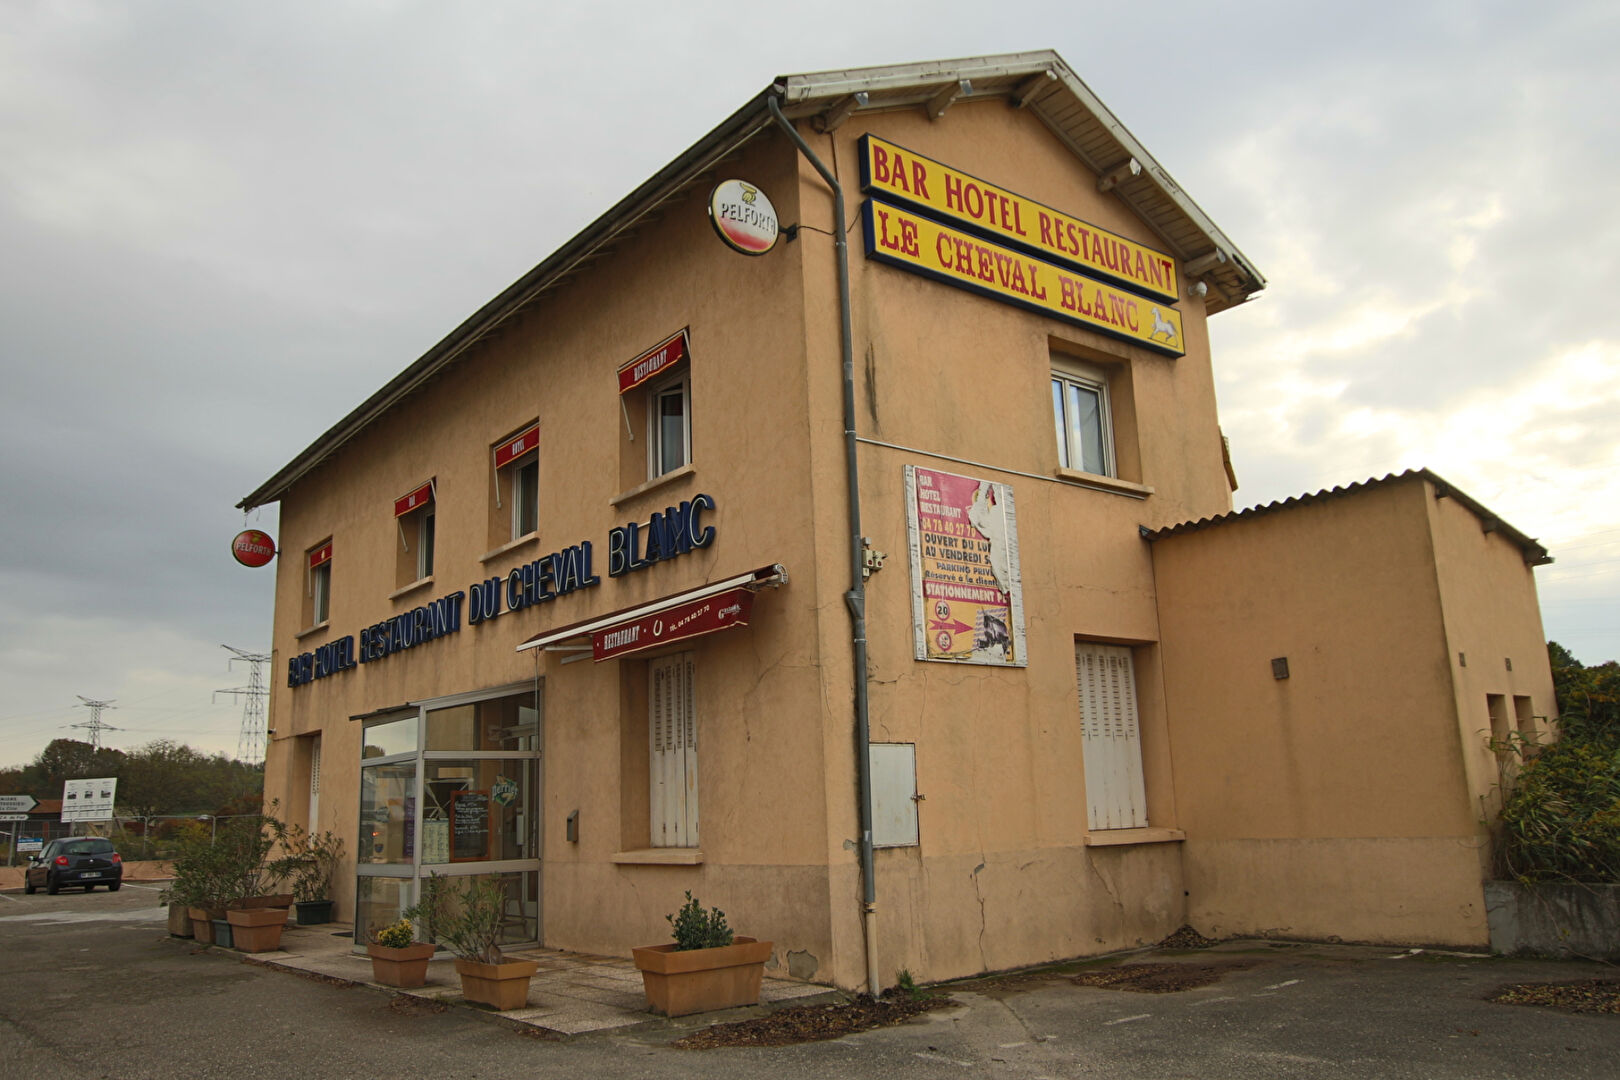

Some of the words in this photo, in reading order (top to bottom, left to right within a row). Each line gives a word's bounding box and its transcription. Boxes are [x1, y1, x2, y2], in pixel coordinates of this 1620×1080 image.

[872, 144, 930, 200] BAR
[944, 173, 1027, 237] HOTEL
[1038, 210, 1173, 292] RESTAURANT
[877, 209, 920, 258] LE
[936, 231, 1048, 302] CHEVAL
[1058, 274, 1140, 333] BLANC
[919, 474, 933, 487] BAR
[919, 488, 941, 502] HOTEL
[920, 501, 962, 519] RESTAURANT
[922, 517, 932, 531] 04
[944, 520, 954, 534] 40
[955, 523, 965, 537] 27
[236, 542, 272, 556] PELFORTH
[924, 532, 958, 548] OUVERT
[961, 538, 974, 550] DU
[925, 545, 937, 557] AU
[939, 547, 982, 564] VENDREDI
[984, 554, 991, 565] S
[936, 562, 971, 574] PARKING
[315, 635, 357, 680] HOTEL
[359, 591, 465, 664] RESTAURANT
[469, 576, 501, 625] DU
[507, 541, 601, 611] CHEVAL
[608, 493, 716, 577] BLANC
[925, 582, 995, 603] STATIONNEMENT
[937, 605, 949, 616] 20
[603, 625, 641, 651] RESTAURANT
